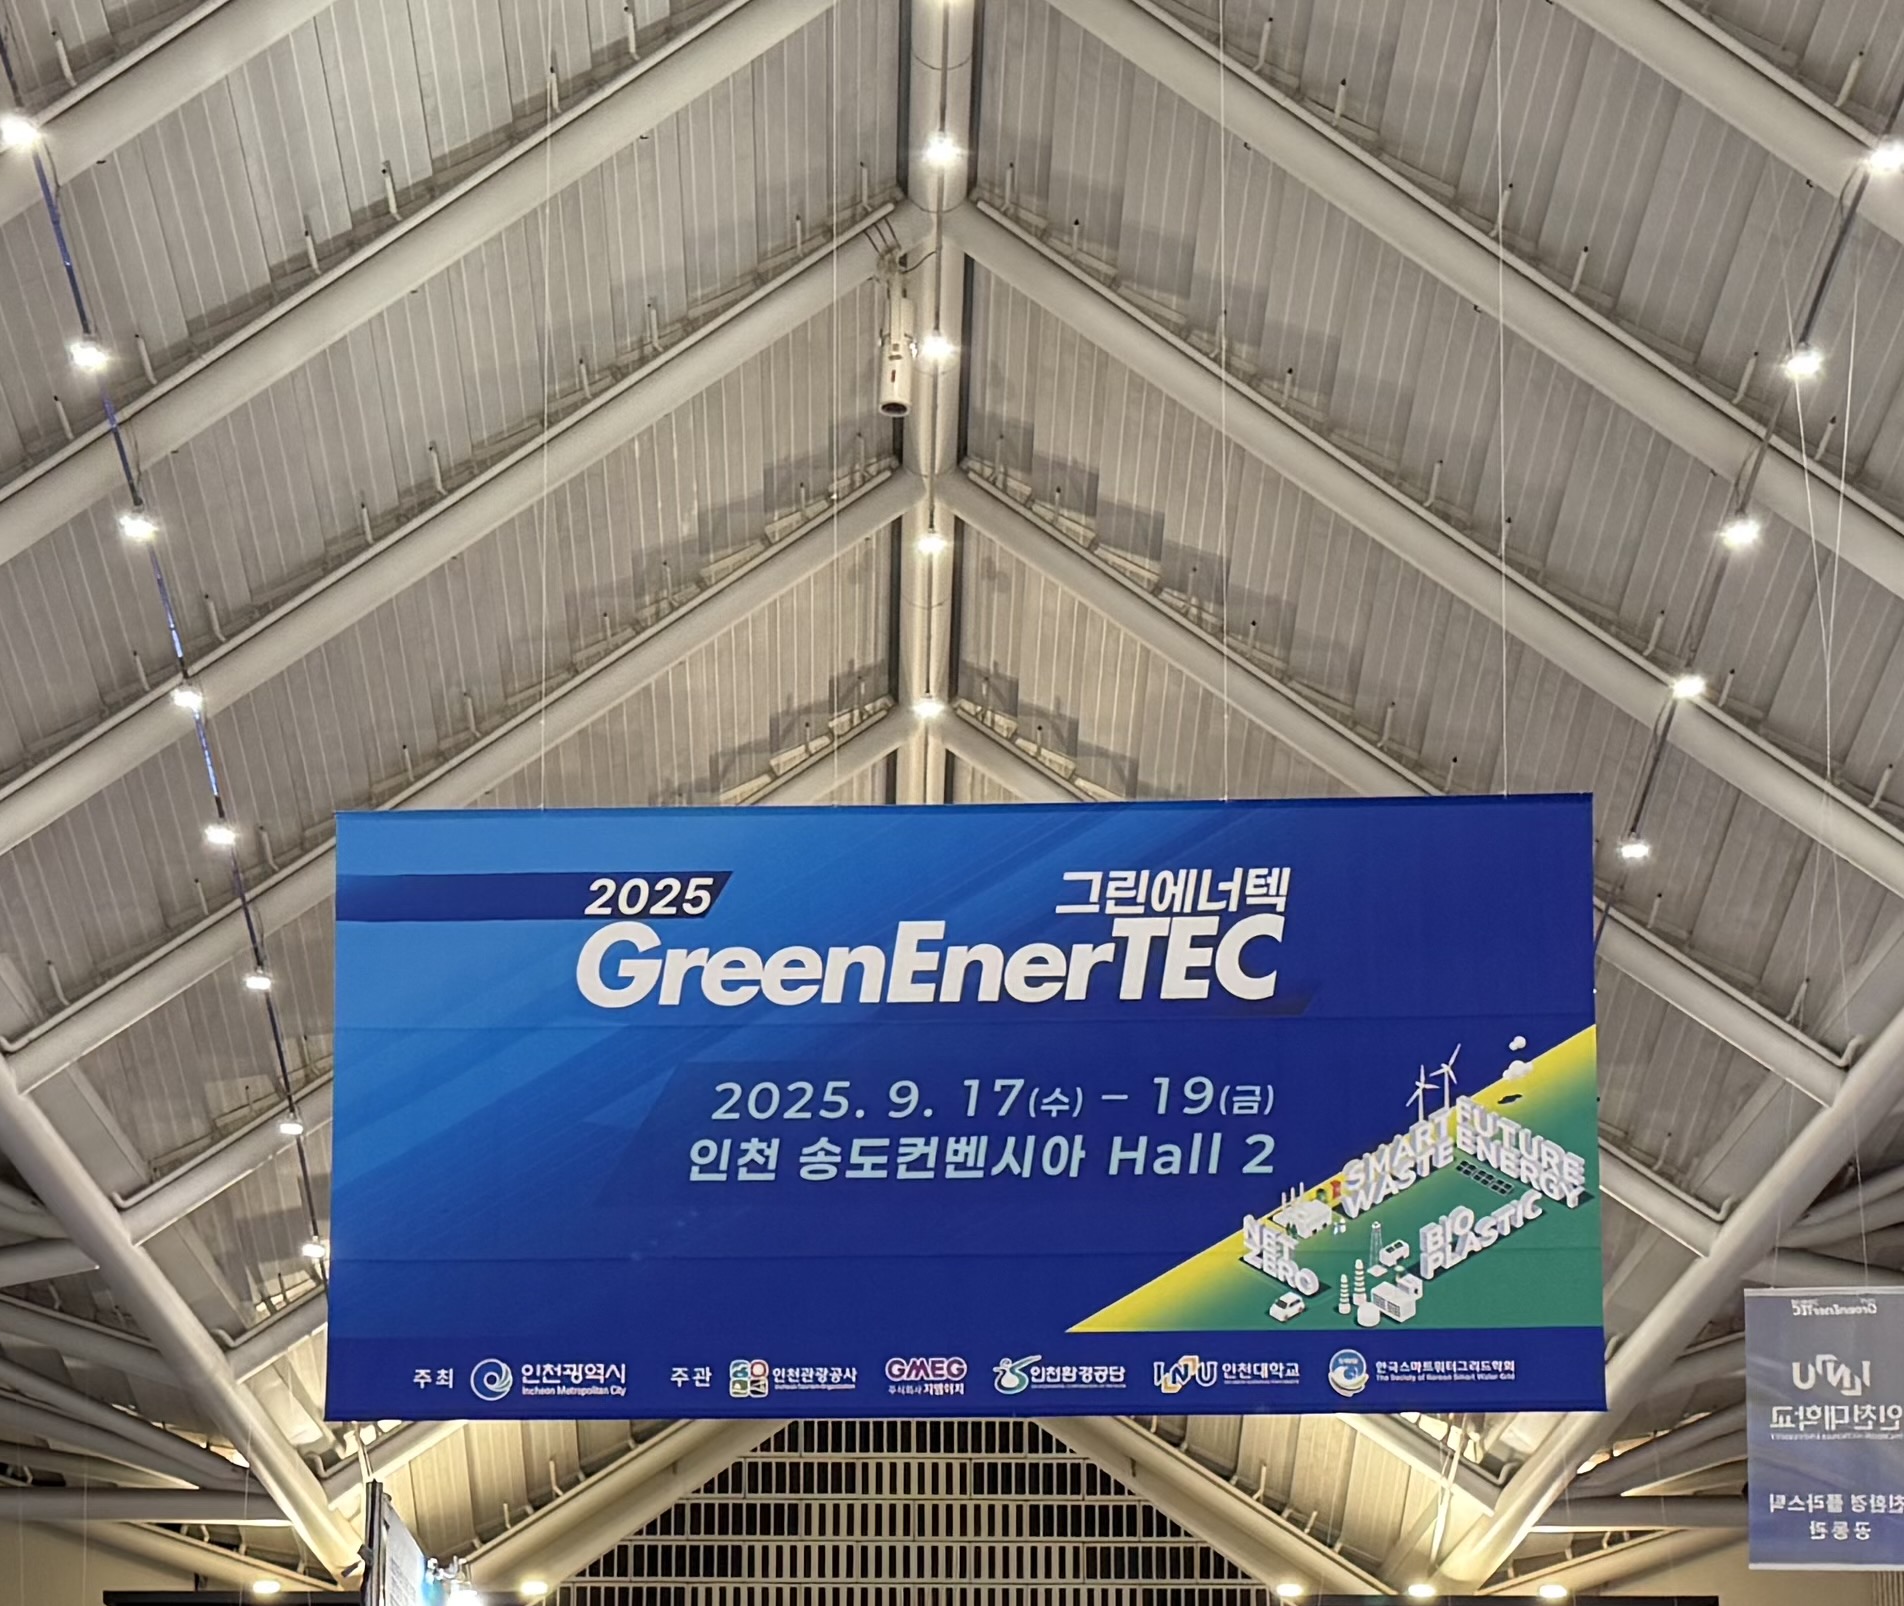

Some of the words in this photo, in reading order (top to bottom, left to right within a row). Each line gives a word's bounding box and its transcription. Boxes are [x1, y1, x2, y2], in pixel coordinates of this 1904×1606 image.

[584, 876, 716, 915] 2025
[1055, 865, 1291, 916] 그린에너텍
[576, 916, 1286, 1009] GreenEnerTEC
[711, 1079, 864, 1121] 2025.
[887, 1079, 936, 1120] 9.
[962, 1076, 1085, 1119] 17(수)
[1152, 1076, 1275, 1119] 19(금)
[688, 1136, 780, 1182] 인천
[799, 1132, 1085, 1180] 송도컨벤시아
[1108, 1130, 1220, 1179] Hall
[1242, 1132, 1276, 1176] 2
[1343, 1106, 1451, 1190] SMART
[1456, 1095, 1585, 1187] FUTURE
[1341, 1141, 1455, 1218] WASTE
[1456, 1127, 1585, 1208] ENERGY
[1243, 1214, 1298, 1262] NET
[1419, 1205, 1475, 1253] BIO
[1243, 1248, 1319, 1296] ZERO
[1419, 1189, 1543, 1279] PLASTIC
[521, 1363, 626, 1384] 인천광역시
[773, 1367, 857, 1384] 인천관광공사
[886, 1357, 967, 1382] GMEG
[1030, 1366, 1126, 1383] 인천환경공단
[1222, 1362, 1300, 1380] 인천대학교
